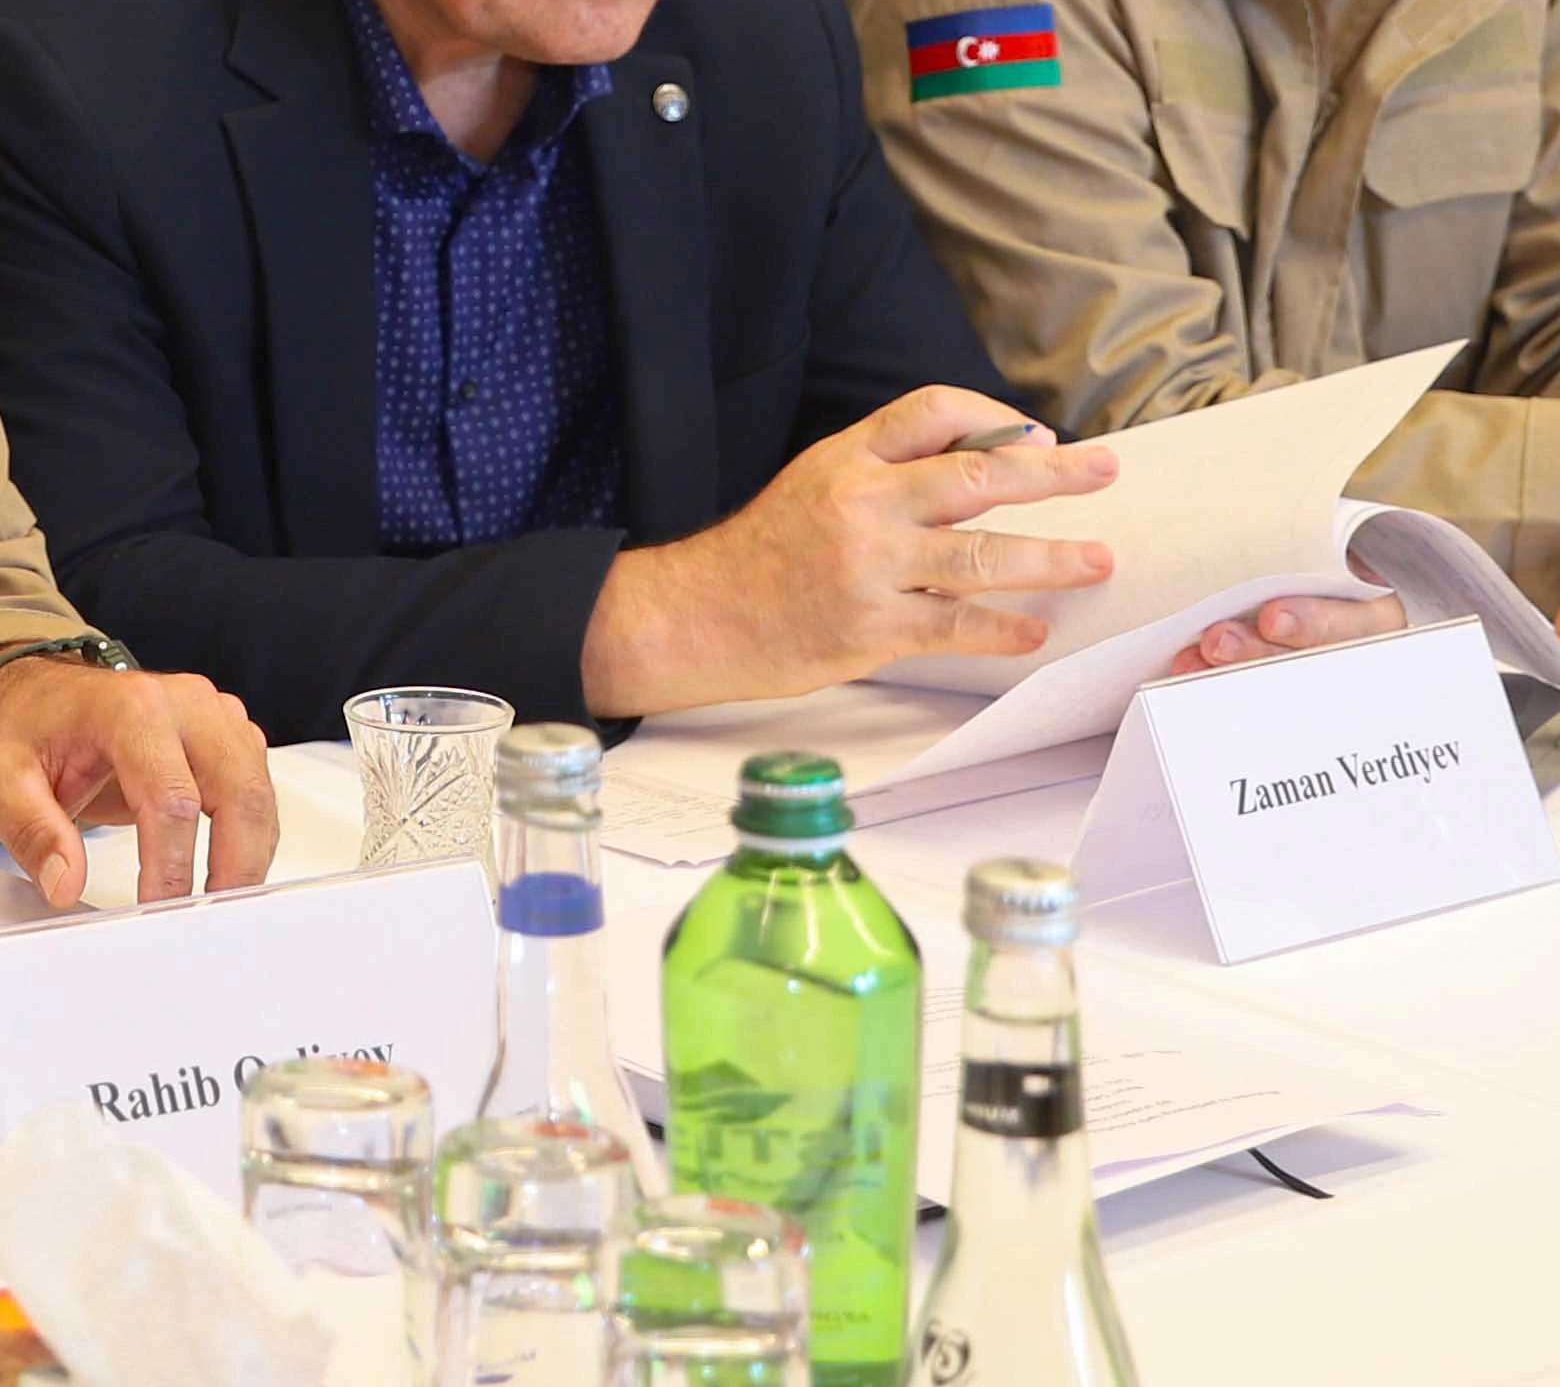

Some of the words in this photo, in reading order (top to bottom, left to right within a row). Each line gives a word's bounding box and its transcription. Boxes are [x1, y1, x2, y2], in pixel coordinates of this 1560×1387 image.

[1229, 770, 1337, 816] Zaman
[1336, 740, 1461, 789] Verdiyev
[85, 1066, 222, 1123] Rahib
